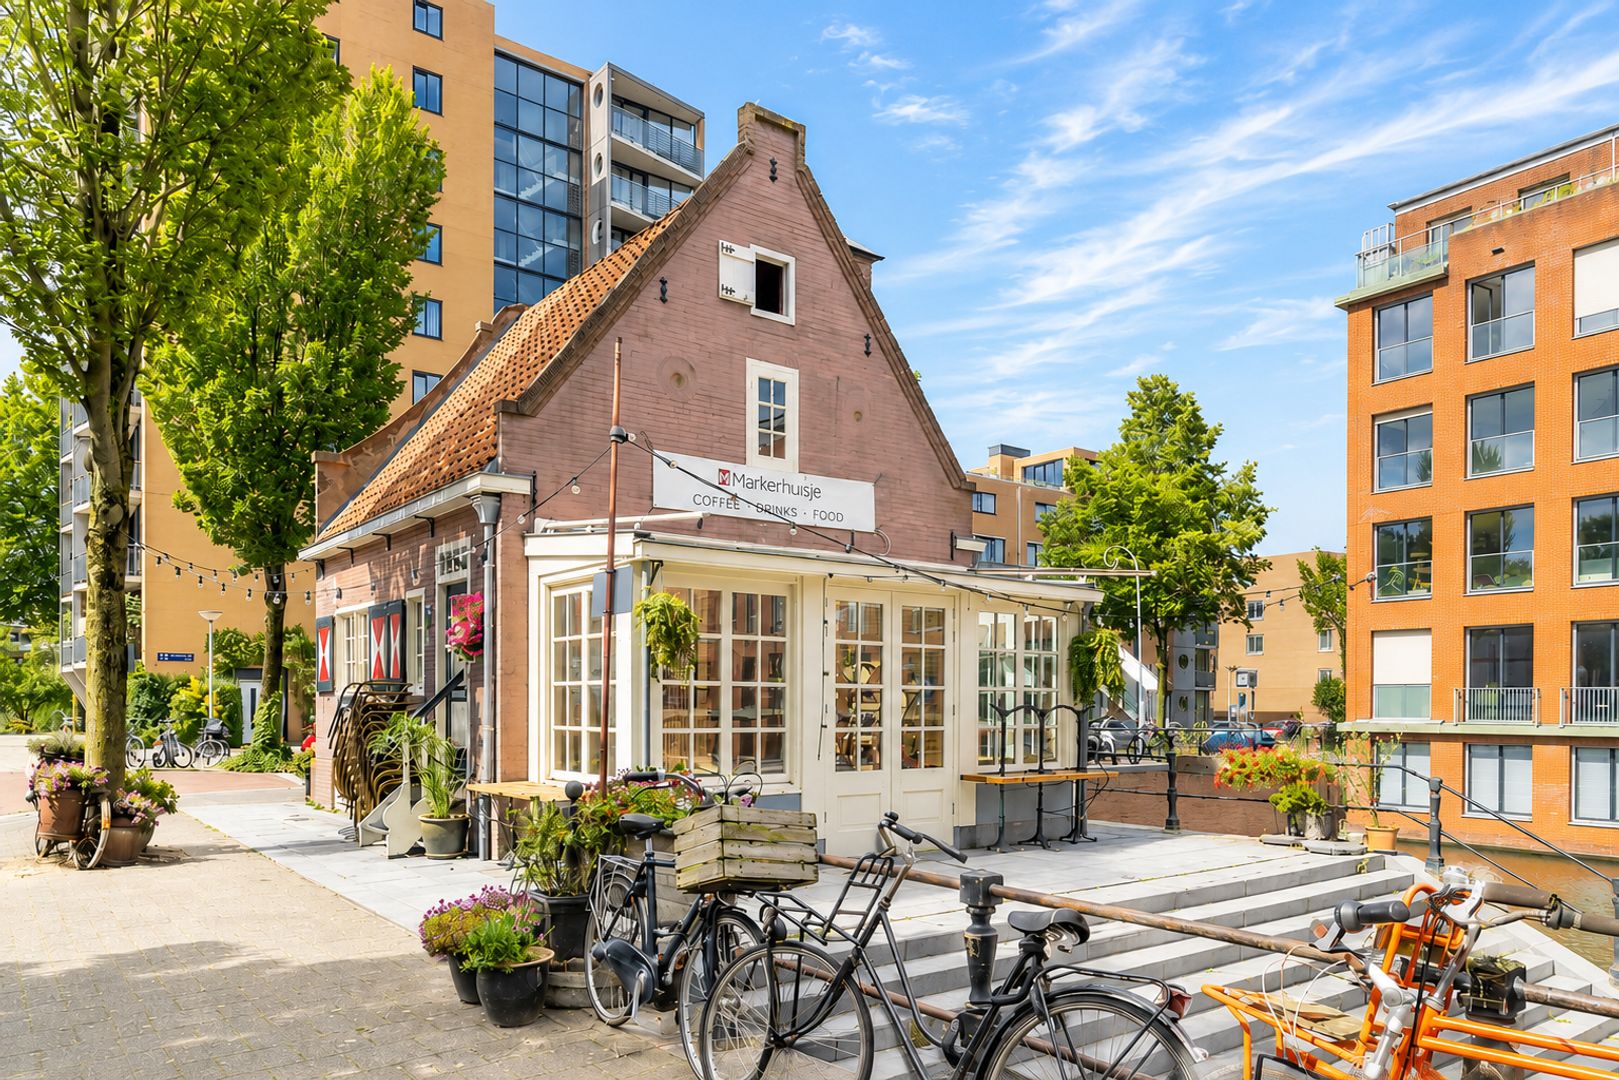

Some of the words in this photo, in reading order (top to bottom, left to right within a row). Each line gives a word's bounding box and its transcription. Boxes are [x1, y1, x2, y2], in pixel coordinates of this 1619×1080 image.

[732, 472, 822, 501] Markerhuisje
[692, 493, 741, 510] COFFEE
[756, 502, 798, 517] DRINKS
[813, 509, 844, 522] FOOD
